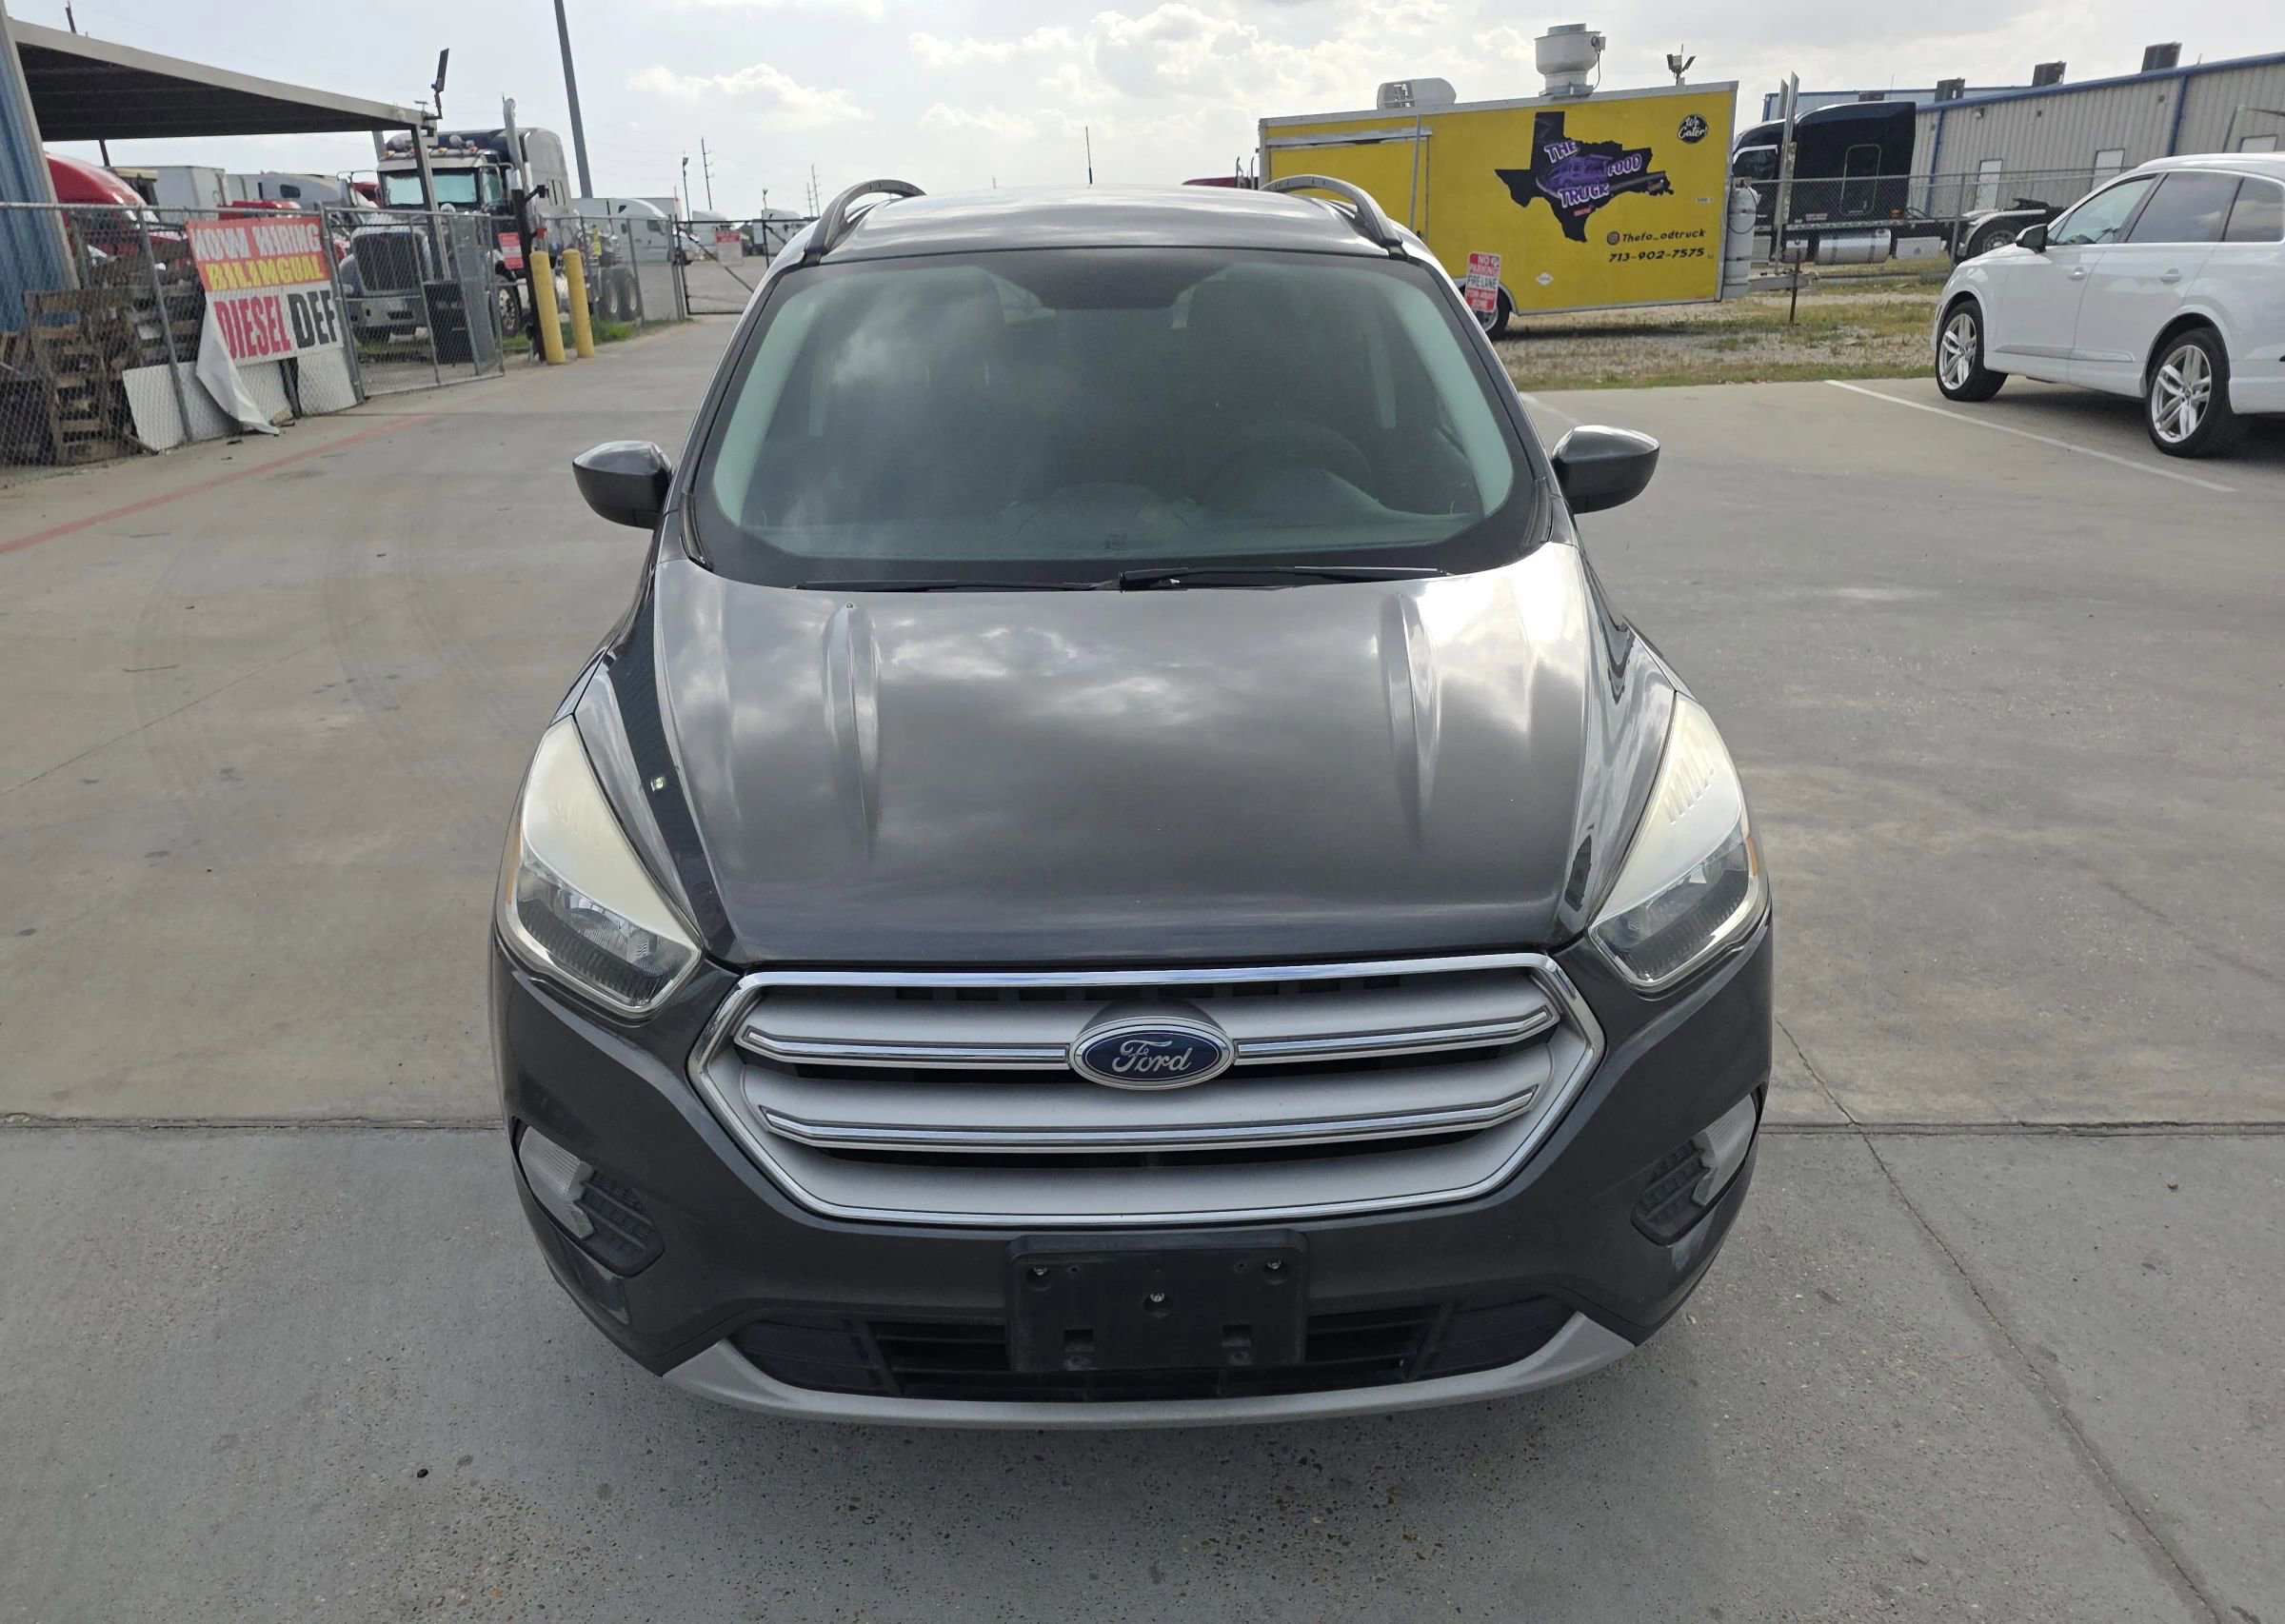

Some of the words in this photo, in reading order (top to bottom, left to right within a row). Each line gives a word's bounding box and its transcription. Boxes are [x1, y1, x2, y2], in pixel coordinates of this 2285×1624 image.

[1543, 141, 1580, 164] THE
[1606, 152, 1643, 177] FOOD
[1558, 183, 1611, 208] TRUCK
[190, 227, 251, 261] NOW
[251, 223, 322, 255] HIRING
[1478, 255, 1491, 267] NO
[1609, 248, 1705, 263] 713-902-7575
[206, 255, 325, 290] BILINGUAL
[1467, 275, 1481, 287] FIRE
[1481, 276, 1498, 289] LANE
[1469, 264, 1500, 276] PARKING
[213, 295, 292, 360] DIESEL
[288, 289, 338, 349] DEF
[1112, 1040, 1192, 1073] Ford
